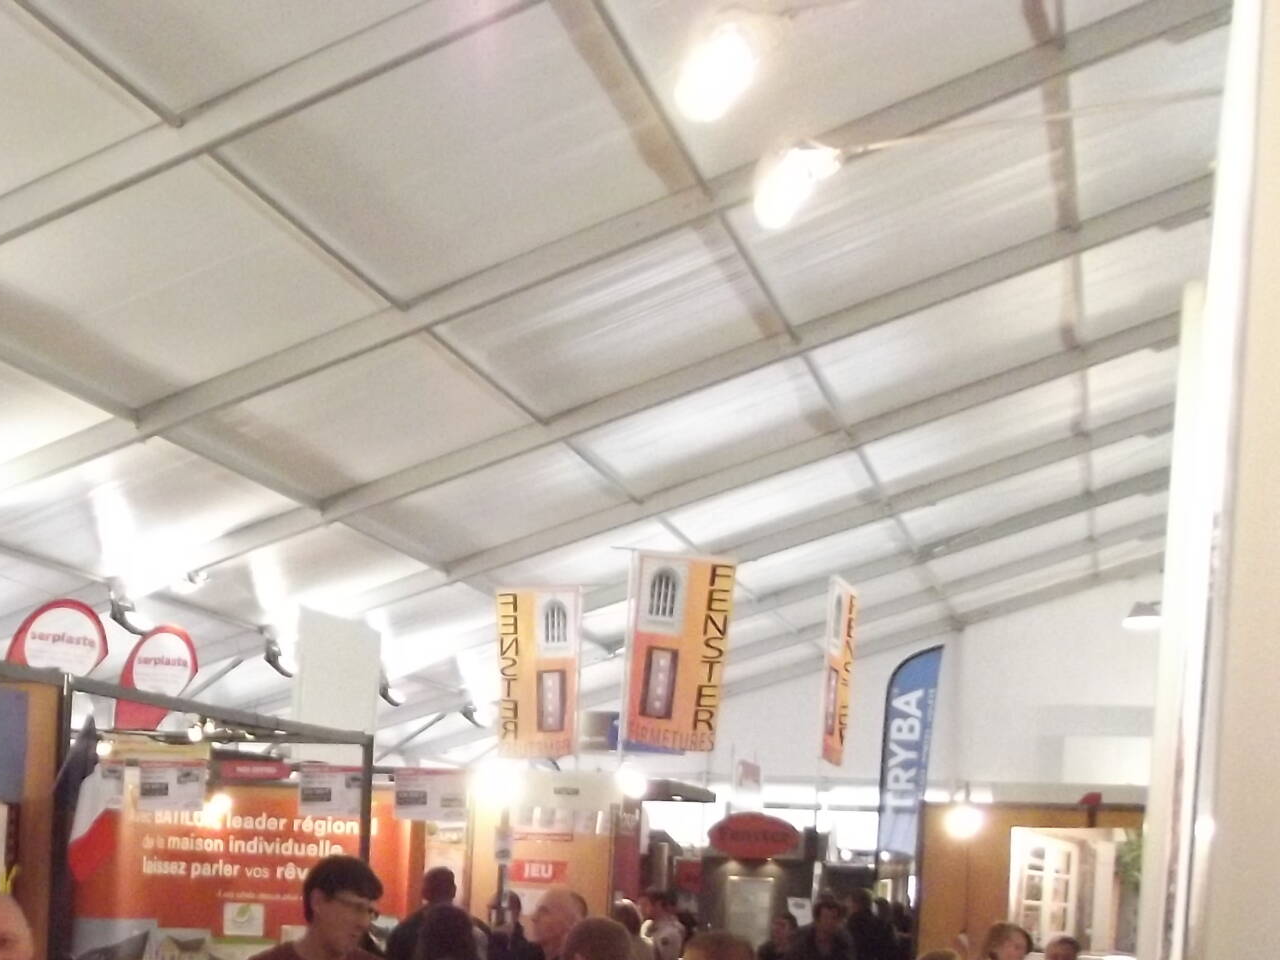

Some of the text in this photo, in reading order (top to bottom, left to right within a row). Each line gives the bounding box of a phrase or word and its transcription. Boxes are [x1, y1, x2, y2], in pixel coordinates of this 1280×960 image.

[30, 630, 97, 648] serplaste
[693, 564, 735, 731] FENSTER
[137, 653, 189, 669] serplaste
[885, 688, 925, 808] TRYBA
[226, 811, 287, 831] leader
[293, 816, 379, 837] régionl
[168, 833, 224, 851] maison
[142, 855, 312, 880] laissez parler vos rêv
[523, 862, 553, 879] JEU
